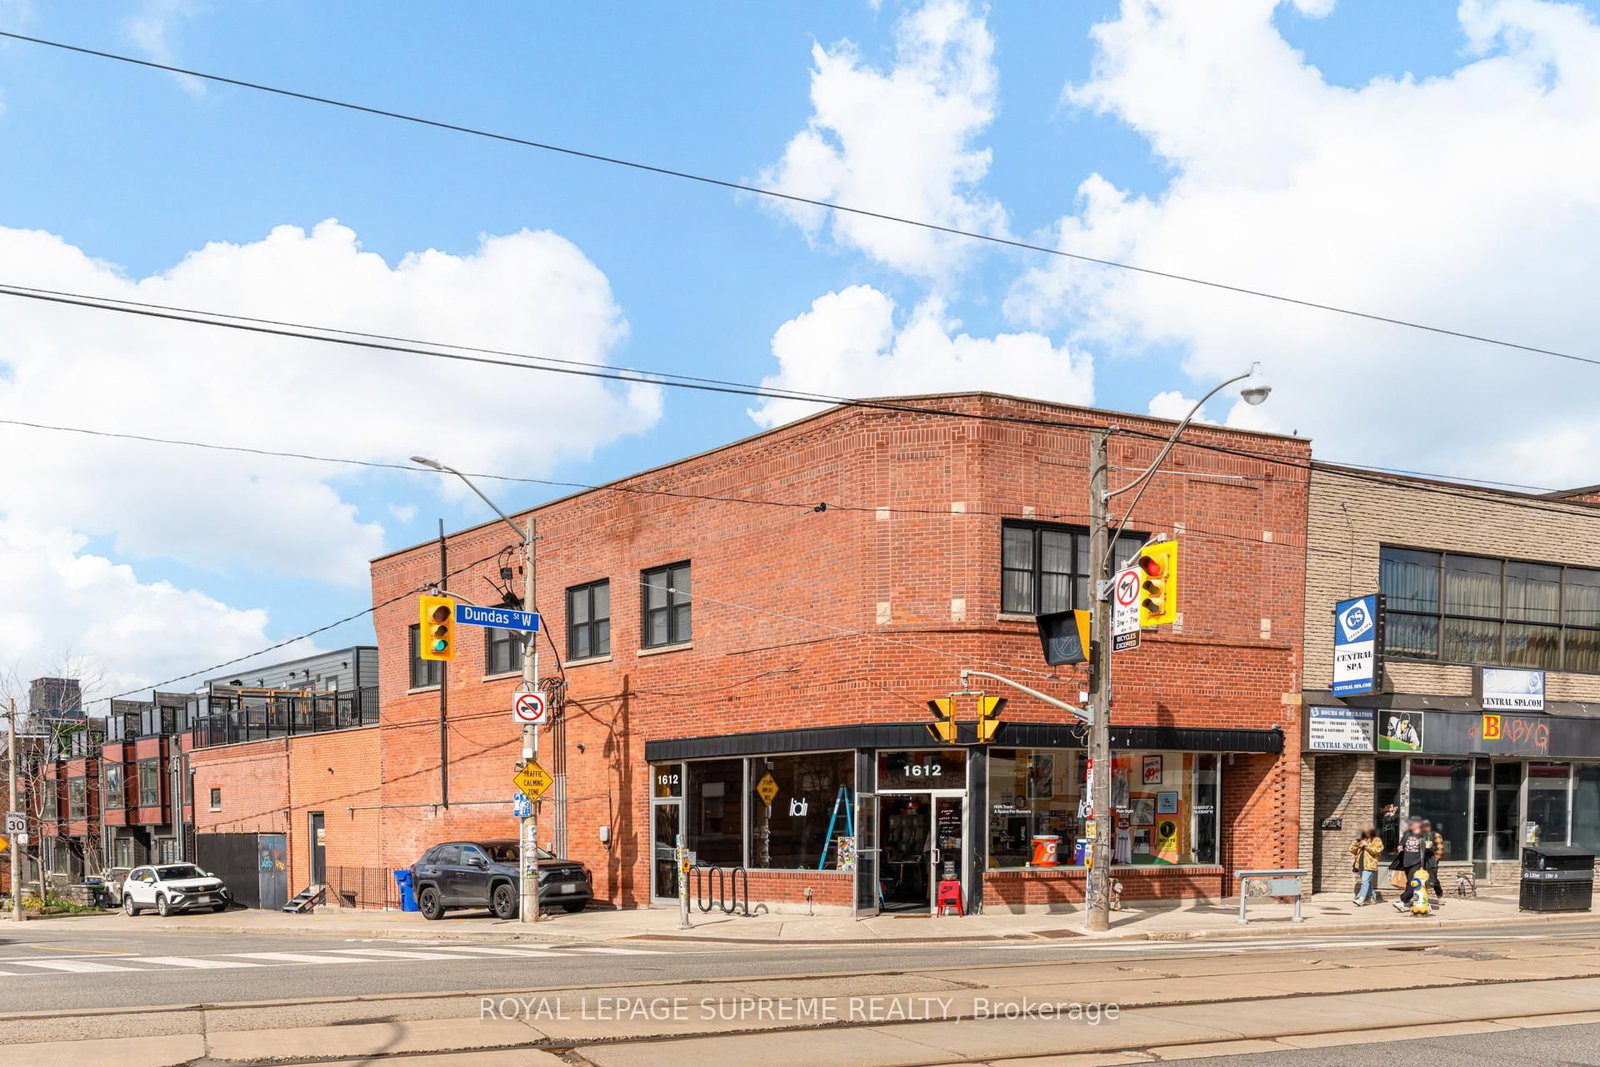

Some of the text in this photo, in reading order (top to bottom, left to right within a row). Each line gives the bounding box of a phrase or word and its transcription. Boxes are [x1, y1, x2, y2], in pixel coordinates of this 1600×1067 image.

[464, 606, 532, 627] Dundas St W
[1347, 610, 1363, 627] CS
[1116, 633, 1137, 642] BICYCLES
[1115, 640, 1137, 650] EXCEPTED
[1337, 651, 1372, 662] CENTRAL
[1346, 662, 1362, 671] SPA
[1482, 697, 1542, 708] CENTRAL SPA.COM
[1313, 741, 1368, 750] CENTRAL SPA.COM
[523, 770, 543, 778] TRAFFIC
[903, 764, 942, 777] 1612
[523, 779, 544, 787] CALMING
[657, 774, 679, 785] 1612
[527, 788, 540, 796] ZONE
[8, 820, 25, 831] 30
[1046, 843, 1056, 854] G
